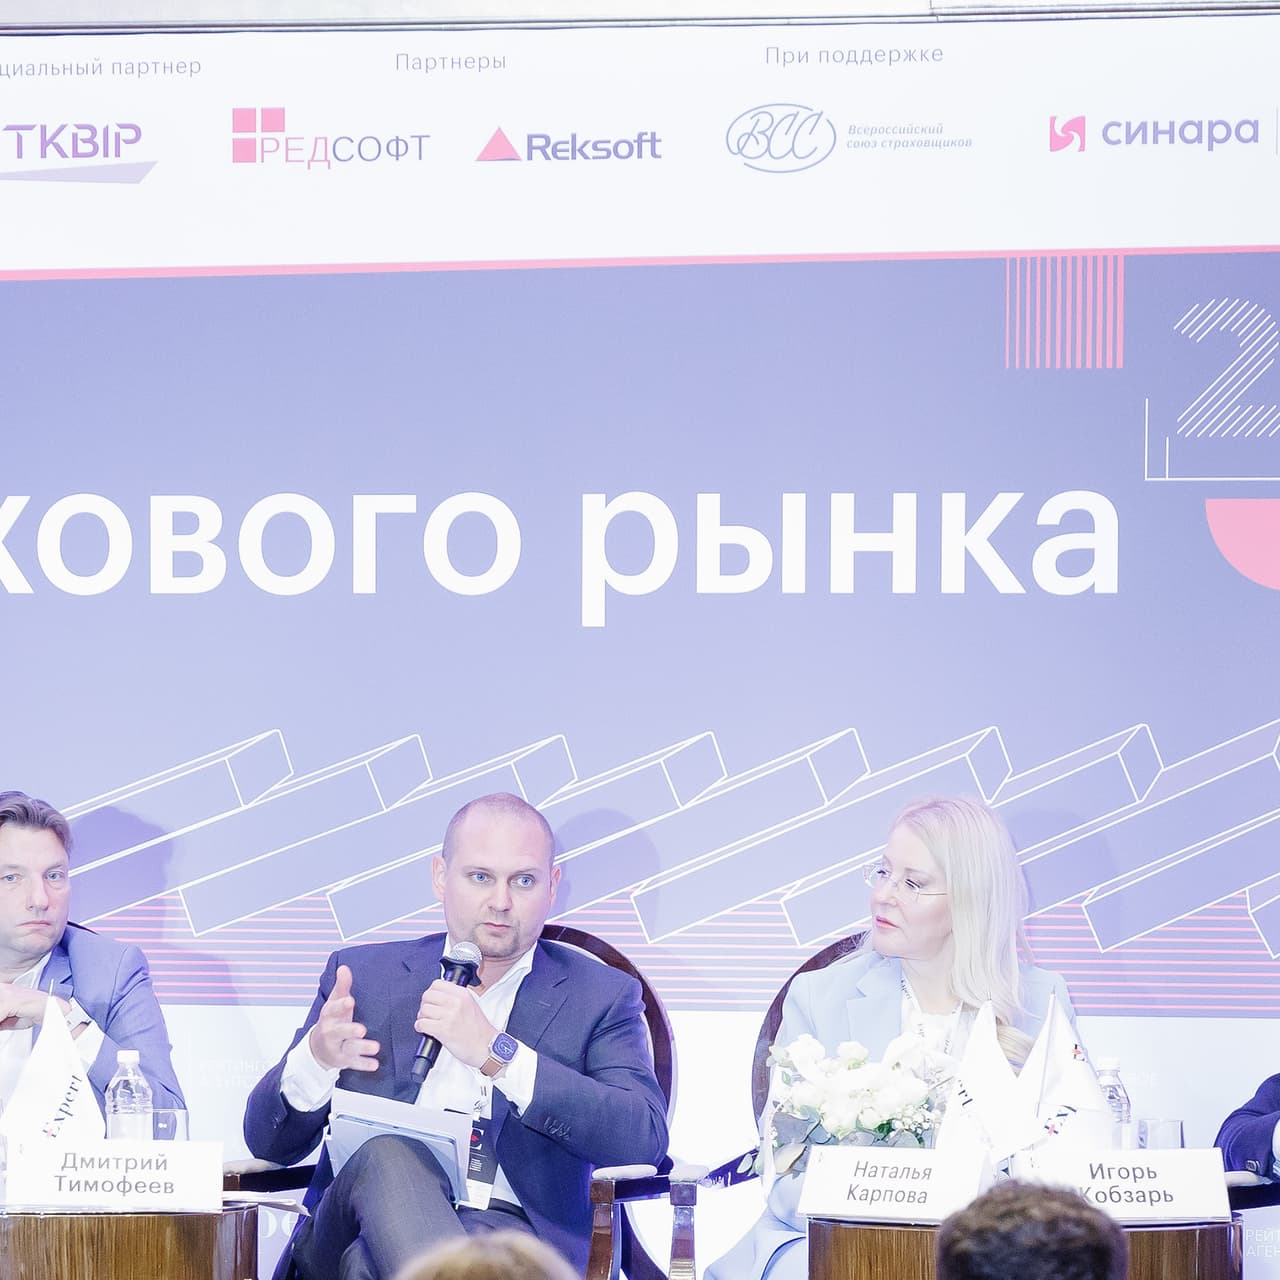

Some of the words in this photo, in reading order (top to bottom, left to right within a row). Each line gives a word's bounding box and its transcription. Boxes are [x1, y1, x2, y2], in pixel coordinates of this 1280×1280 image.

[395, 53, 506, 73] Партнеры
[765, 46, 809, 68] При
[818, 46, 944, 67] поддержке
[111, 59, 202, 79] партнер
[848, 122, 944, 137] Всероссийский
[1101, 118, 1260, 152] синара
[526, 131, 663, 161] Reksoft
[846, 138, 878, 149] союз
[880, 137, 973, 151] страховщиков
[580, 489, 1119, 627] рынка
[41, 1071, 84, 1139] Expert
[60, 1151, 169, 1174] Дмитрий
[853, 1160, 933, 1181] Наталья
[1089, 1161, 1159, 1183] Игорь
[53, 1174, 175, 1197] Тимофеев
[845, 1185, 928, 1205] Карпова
